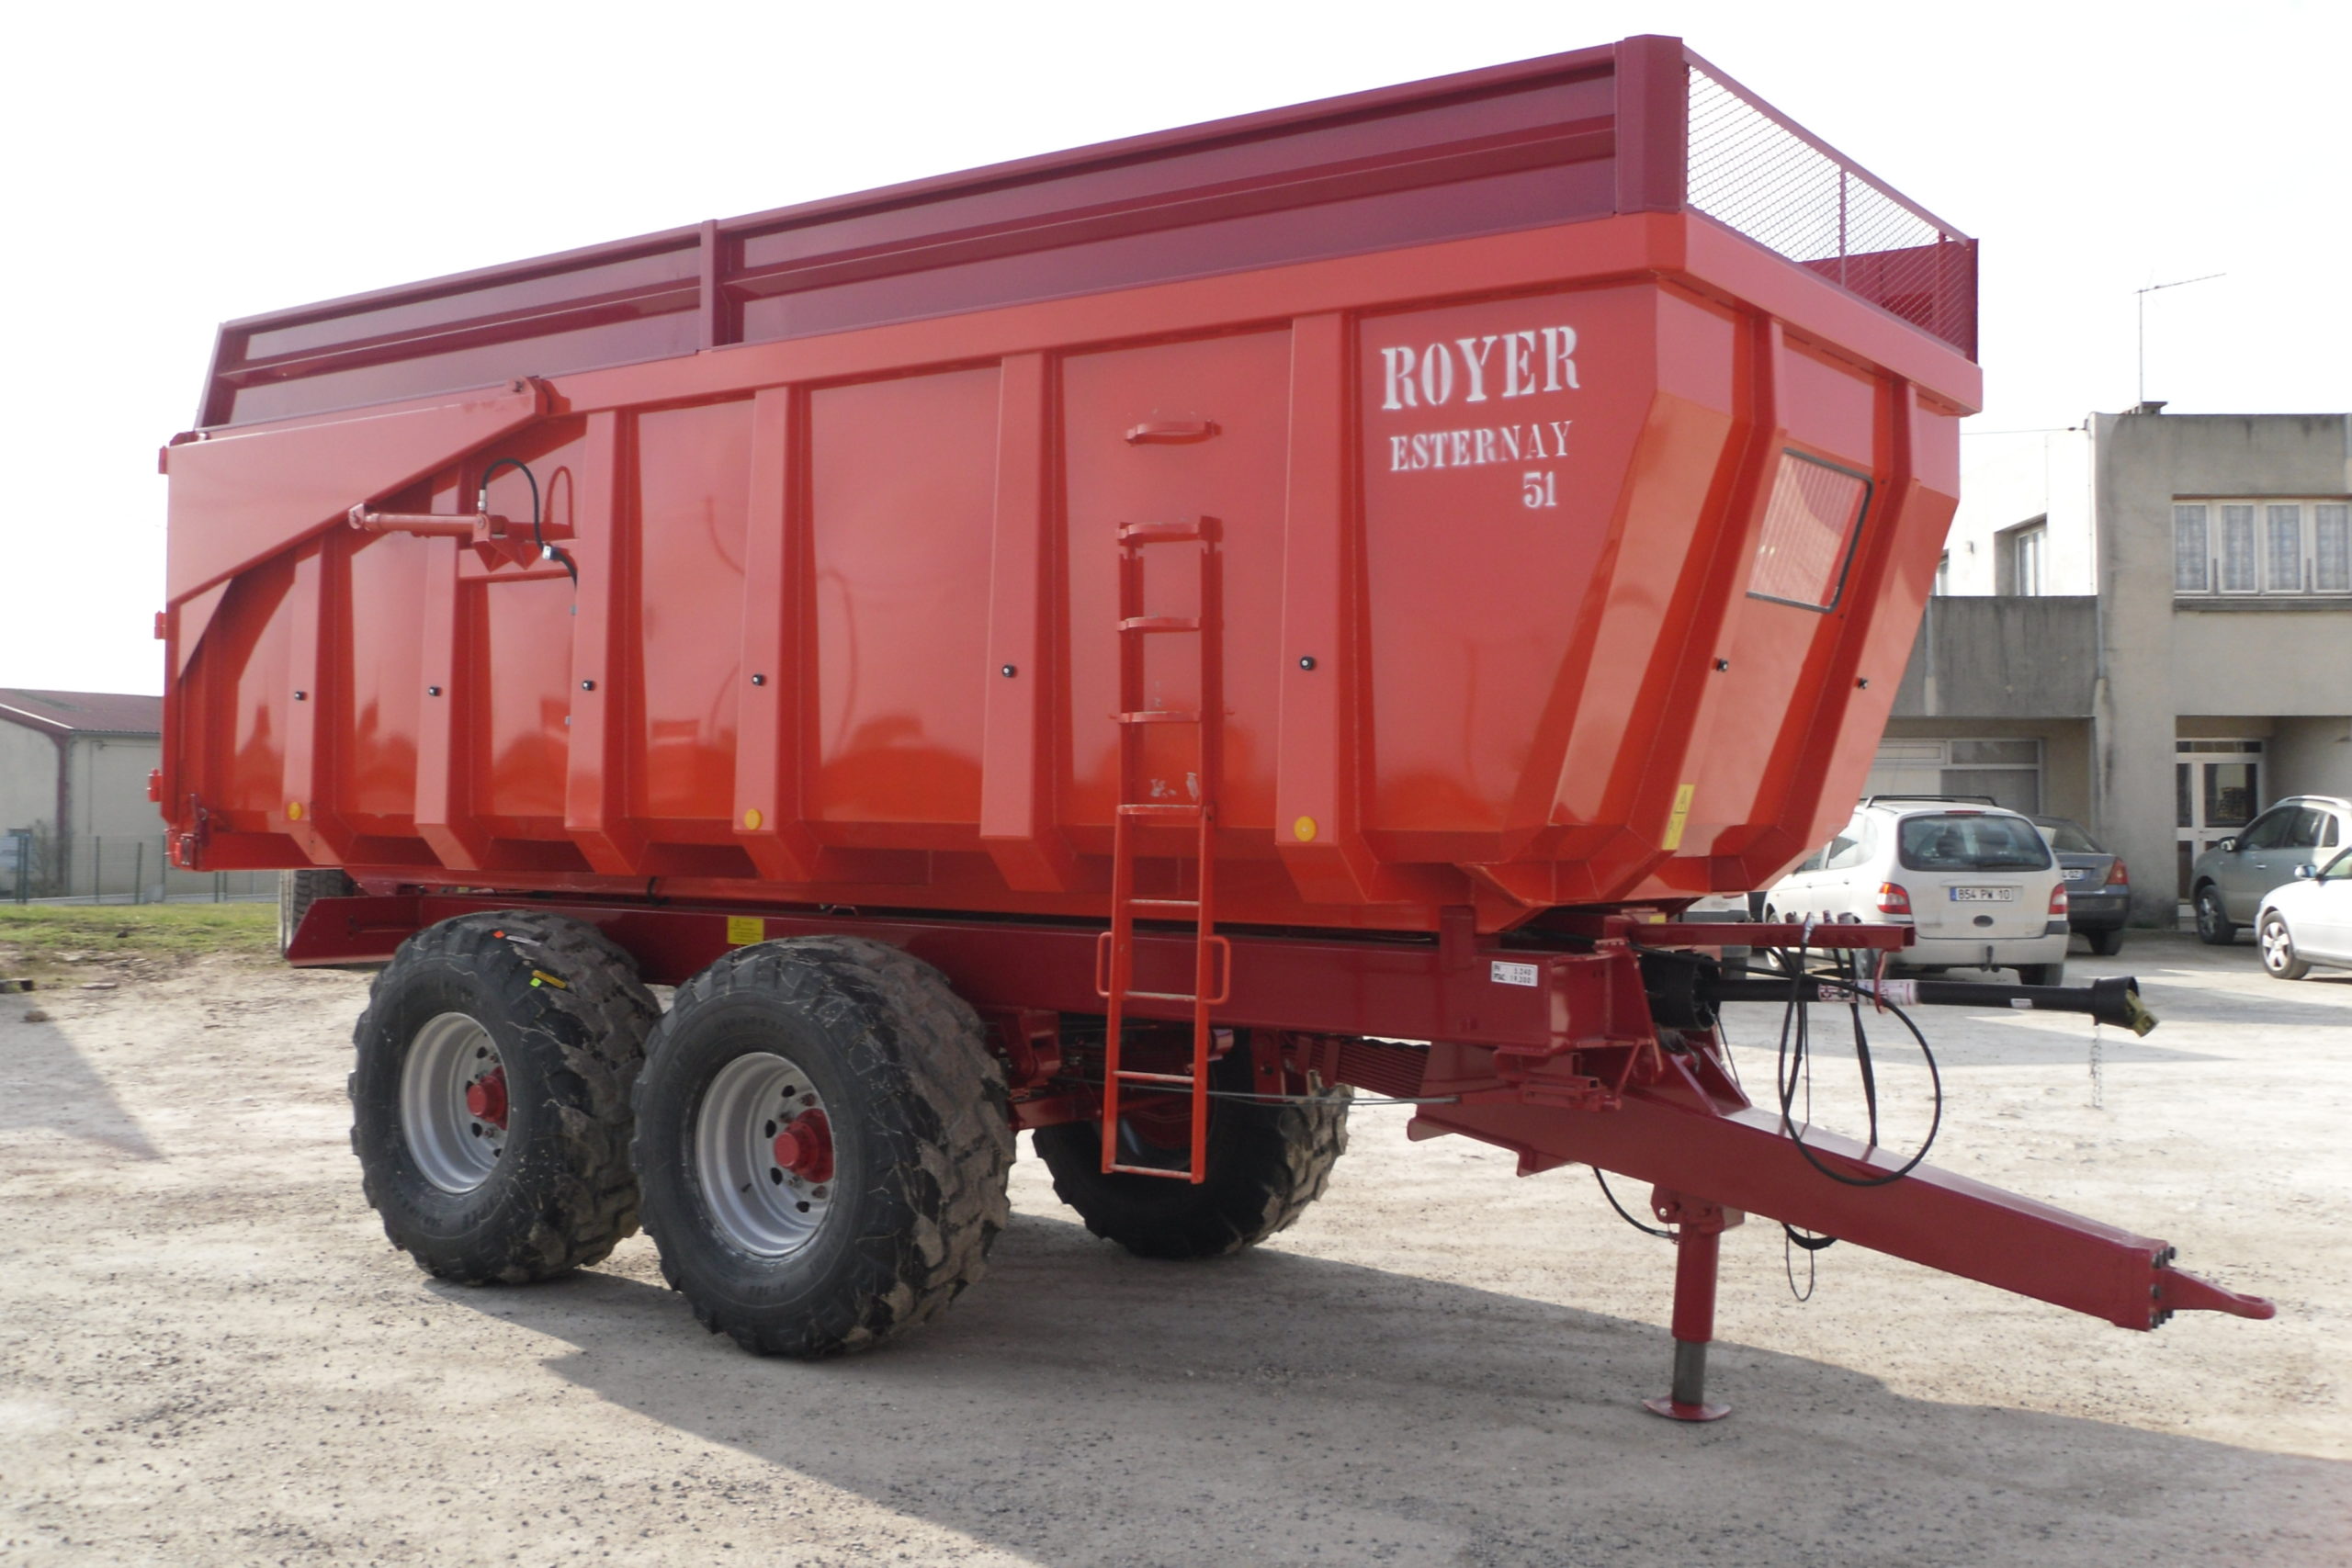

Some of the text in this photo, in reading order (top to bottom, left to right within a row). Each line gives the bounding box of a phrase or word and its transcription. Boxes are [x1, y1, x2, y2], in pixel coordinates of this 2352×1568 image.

[1381, 326, 1580, 410] ROYER
[1389, 421, 1573, 471] ESTERNAY
[1523, 471, 1557, 507] 51
[1958, 889, 1976, 899] 854
